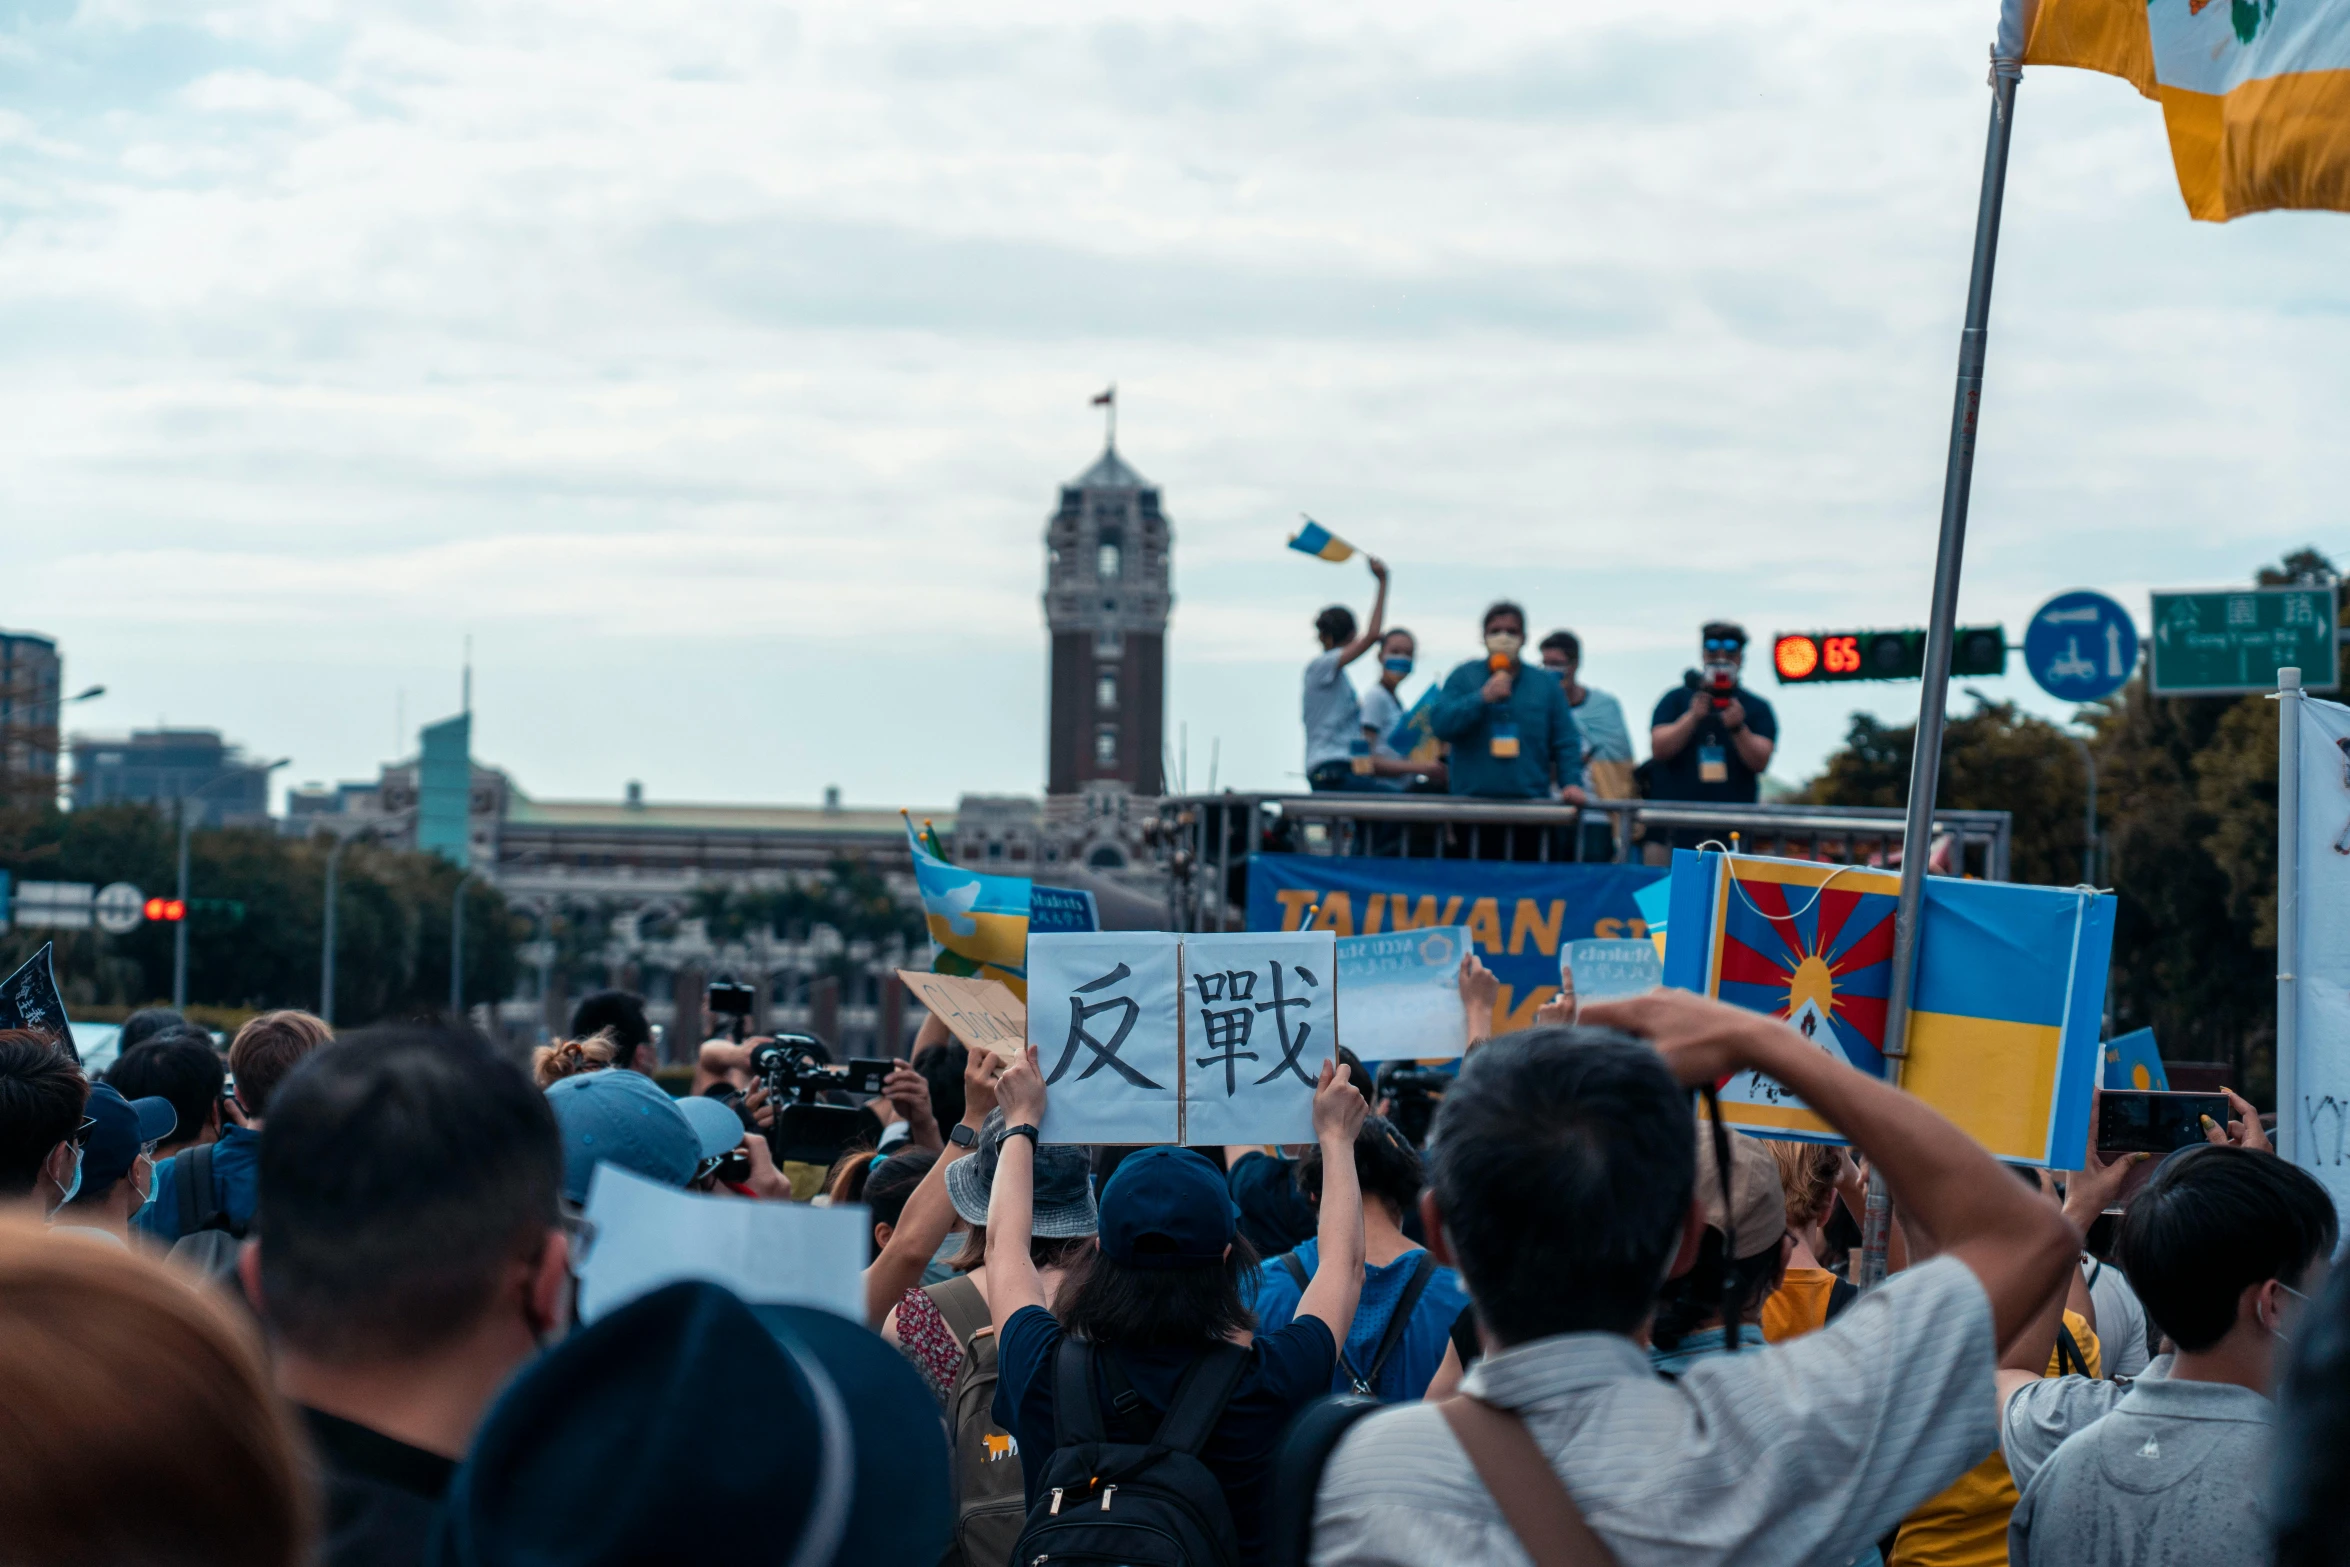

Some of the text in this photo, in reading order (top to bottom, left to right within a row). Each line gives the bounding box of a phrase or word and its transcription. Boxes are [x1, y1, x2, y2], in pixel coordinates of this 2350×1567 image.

[1823, 636, 1861, 673] 65
[1275, 889, 1567, 956] TAIWAN
[1045, 959, 1319, 1098] 反戰
